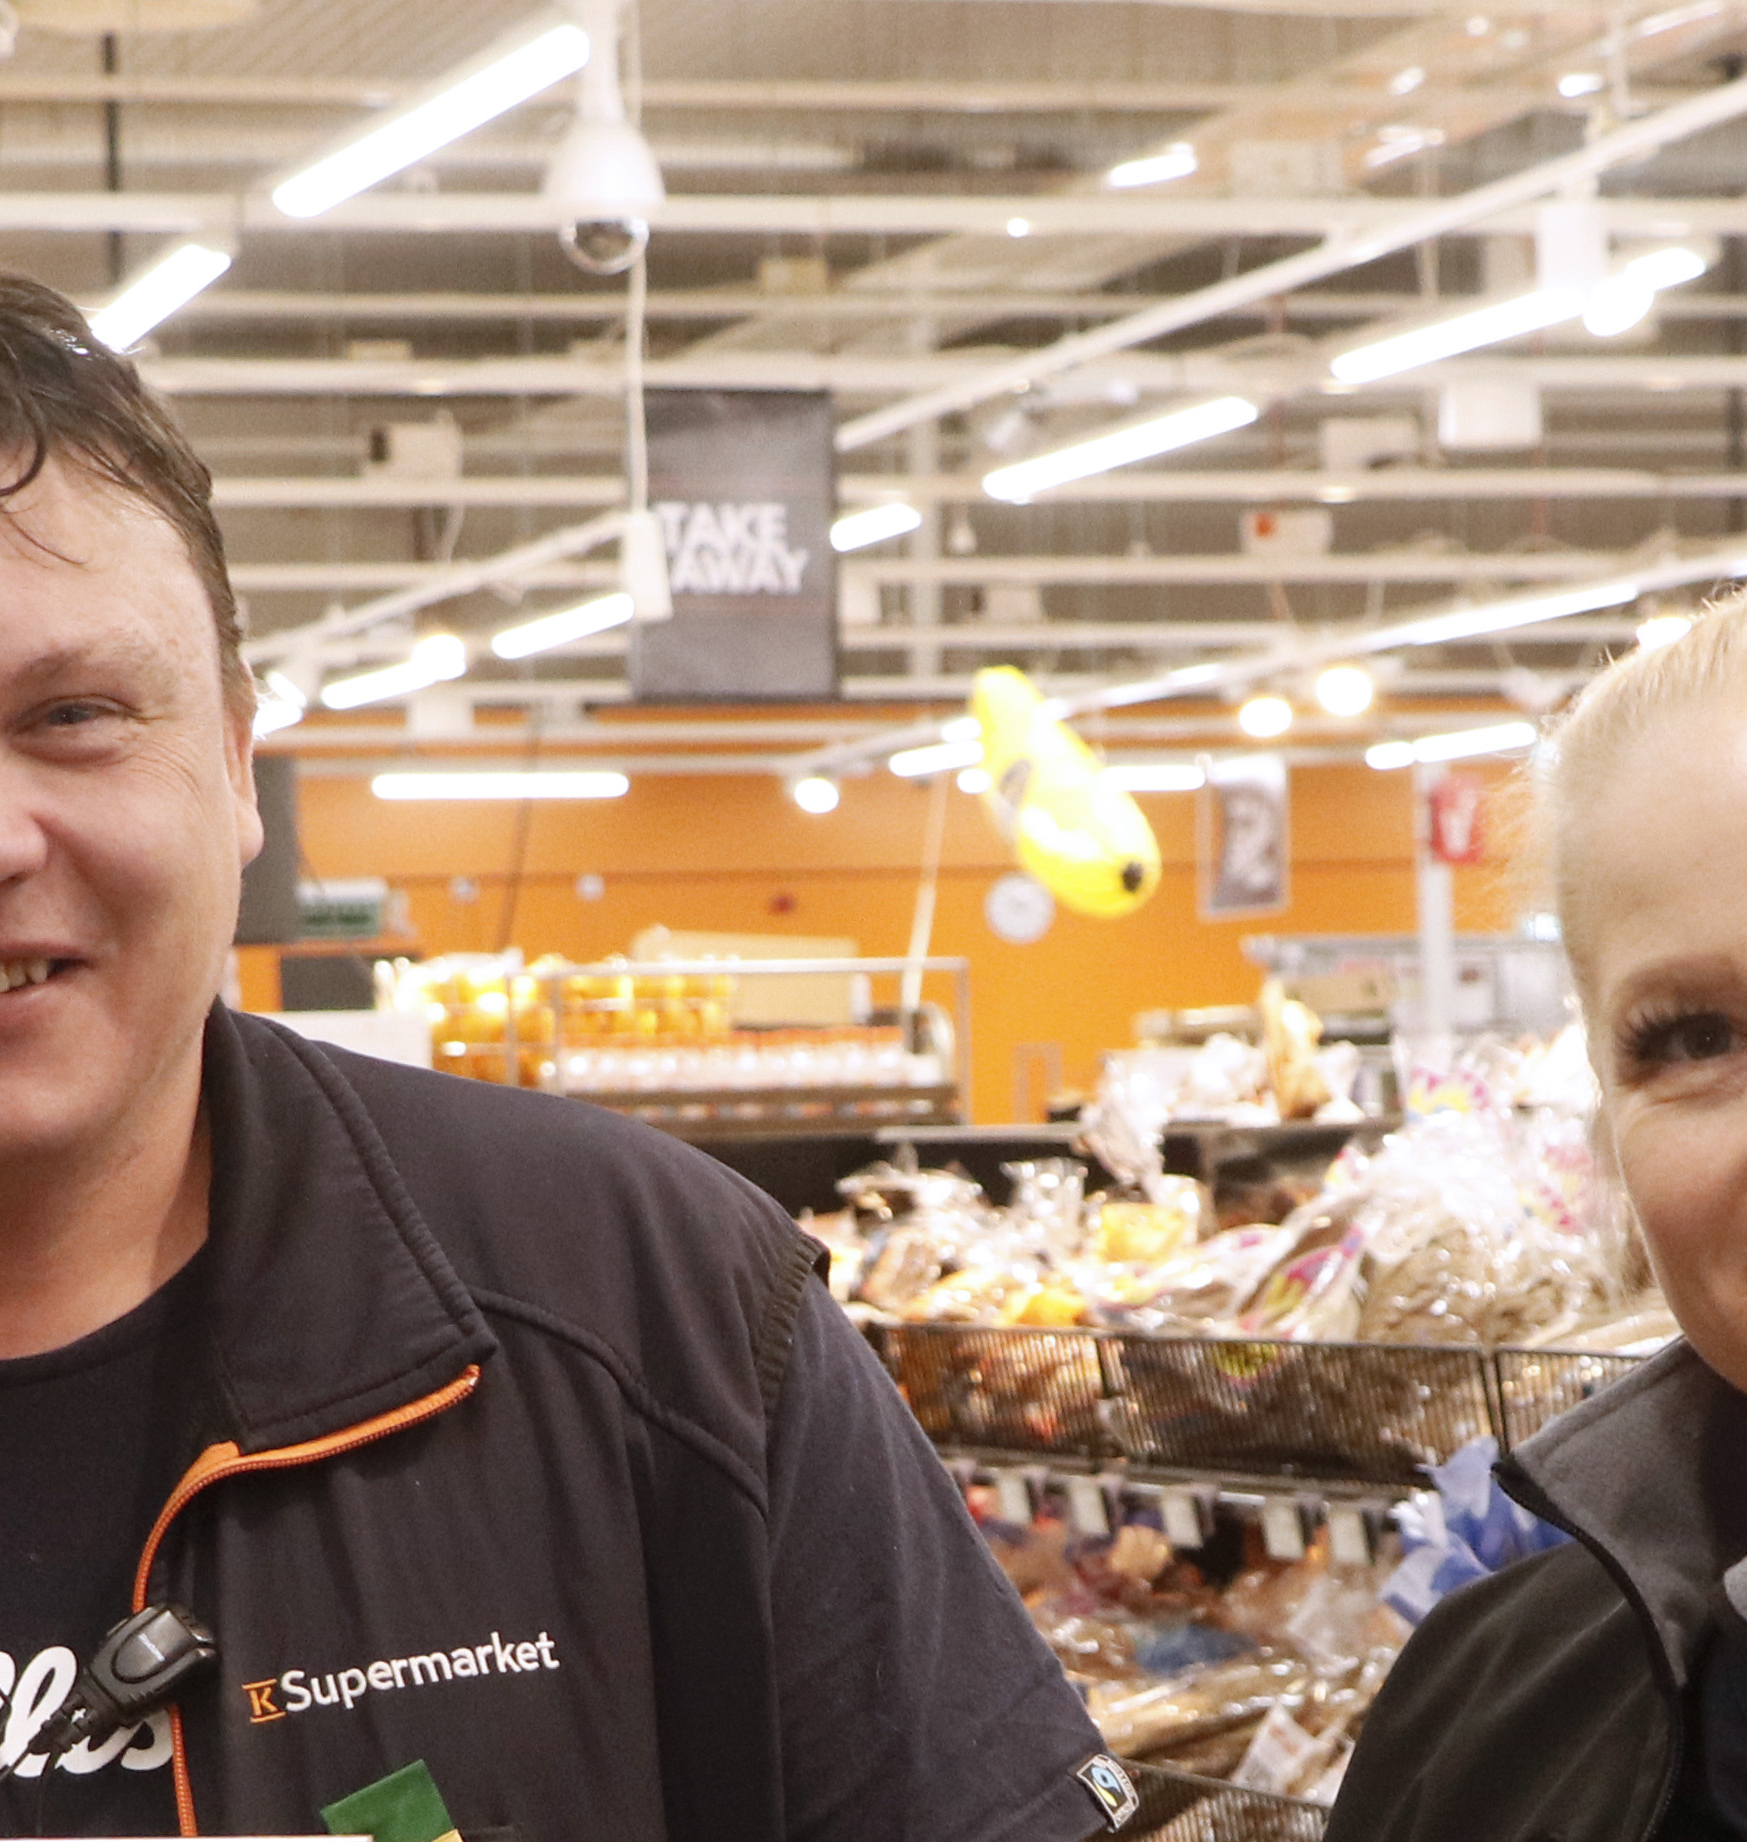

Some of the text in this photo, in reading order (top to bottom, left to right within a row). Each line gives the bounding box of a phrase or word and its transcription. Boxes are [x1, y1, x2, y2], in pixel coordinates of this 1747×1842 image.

[655, 502, 788, 552] TAKE
[670, 548, 810, 595] AWAY
[281, 1631, 560, 1712] Supermarket
